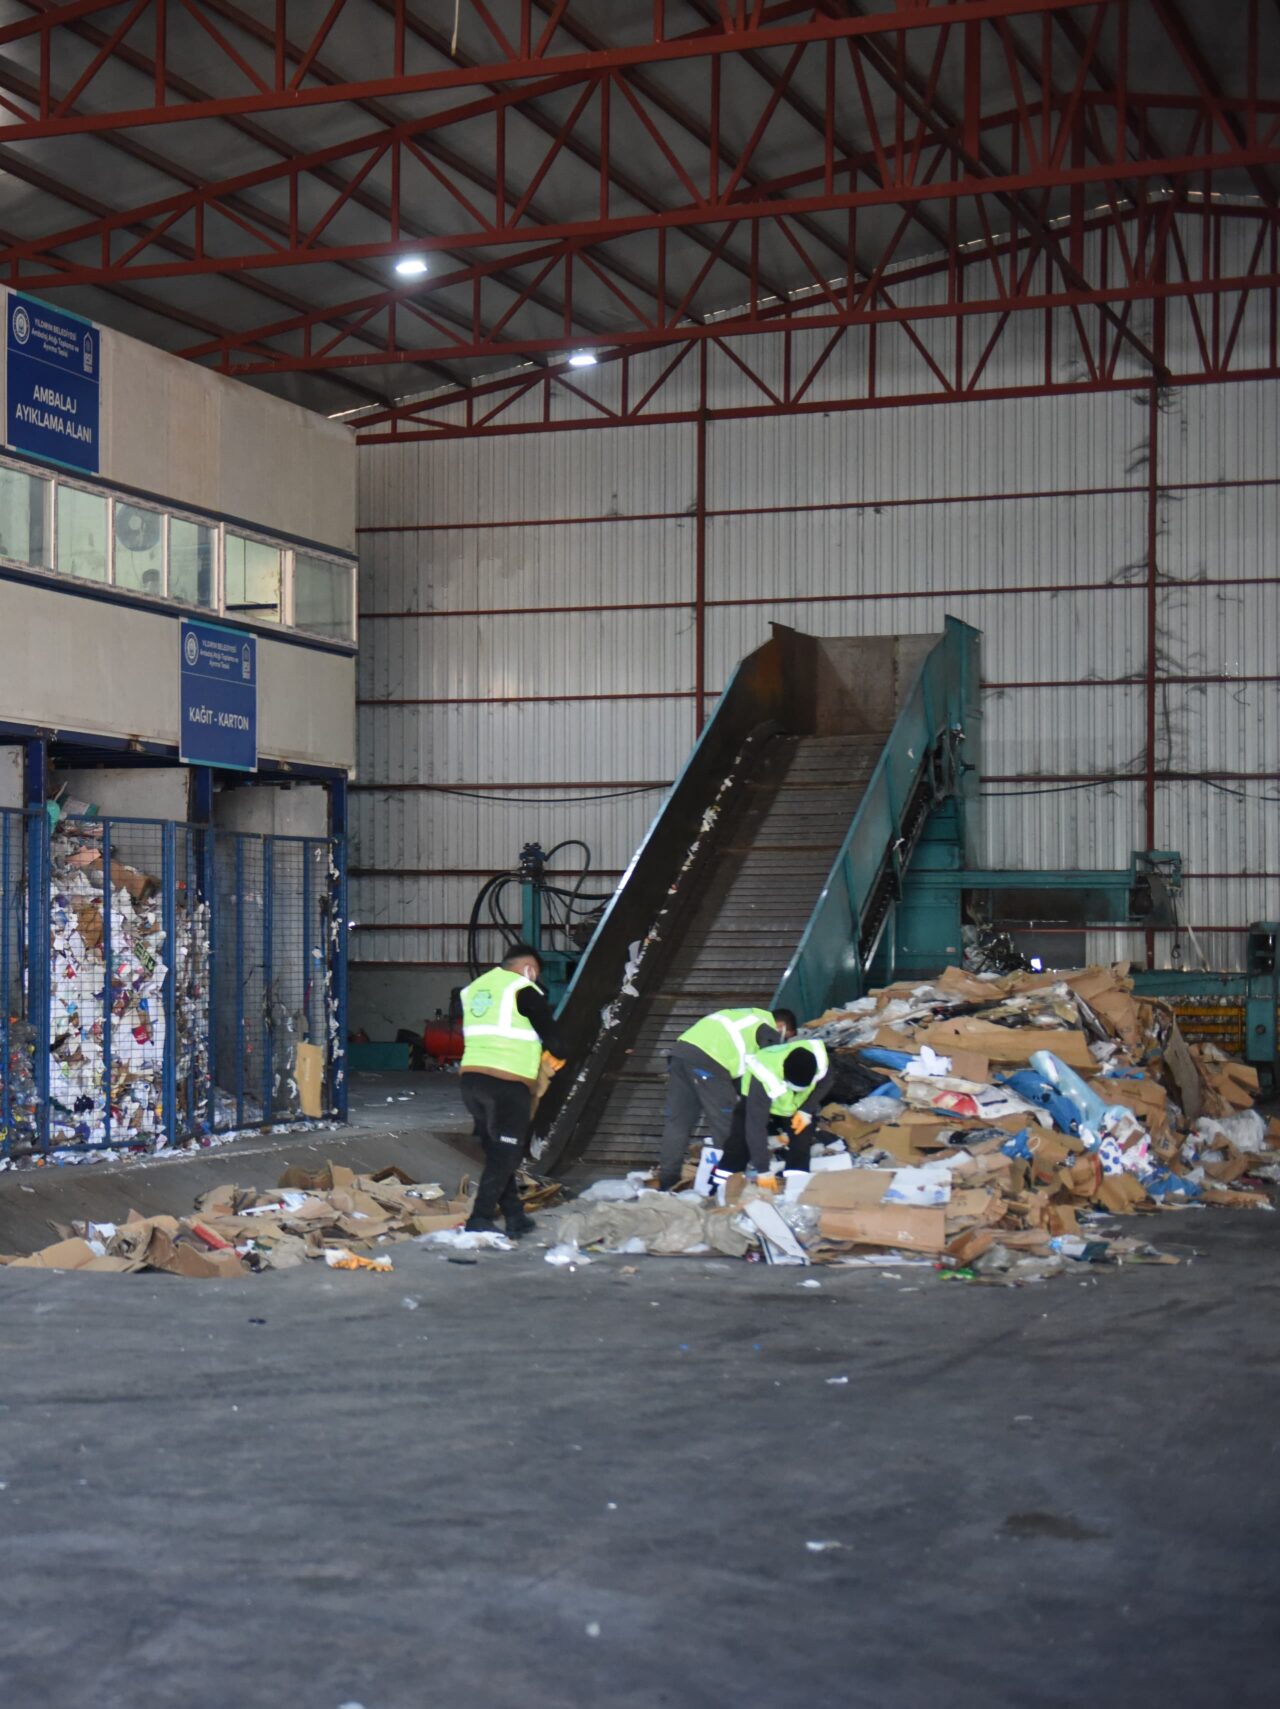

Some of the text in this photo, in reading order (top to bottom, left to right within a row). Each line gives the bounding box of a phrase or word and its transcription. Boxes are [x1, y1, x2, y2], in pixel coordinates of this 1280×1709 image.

[33, 384, 77, 414] AMBALAJ
[15, 402, 92, 444] AYIKLAMA ALANI
[189, 705, 213, 725] KAĞIT
[218, 711, 249, 731] KARTON
